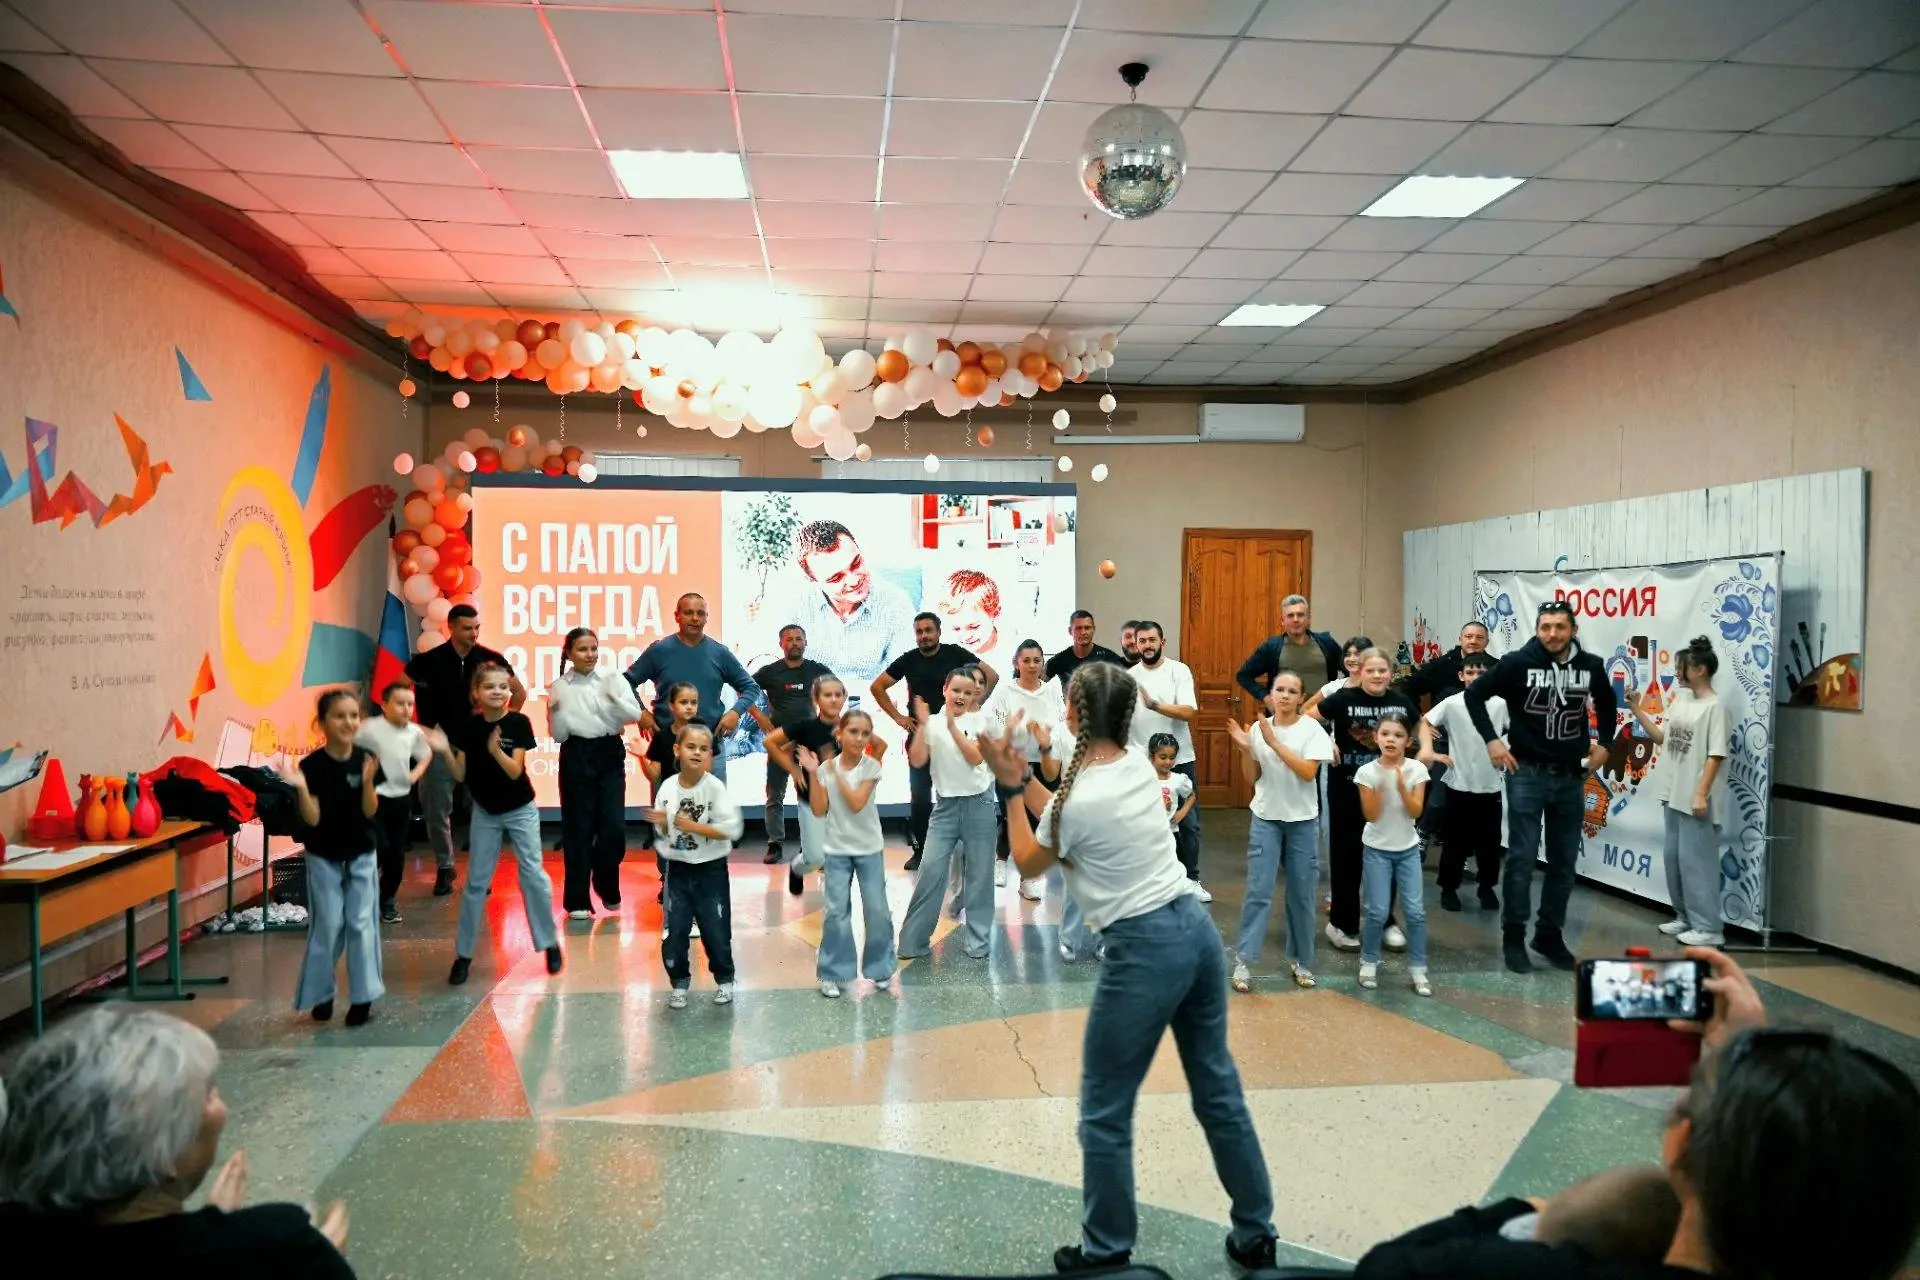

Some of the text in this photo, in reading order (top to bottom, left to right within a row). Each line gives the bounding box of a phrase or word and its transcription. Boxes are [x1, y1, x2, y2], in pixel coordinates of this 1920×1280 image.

[502, 516, 678, 575] С ПАПОЙ
[503, 584, 663, 640] ВСЕГДА
[1524, 687, 1591, 740] 42
[1603, 843, 1651, 878] МОЯ
